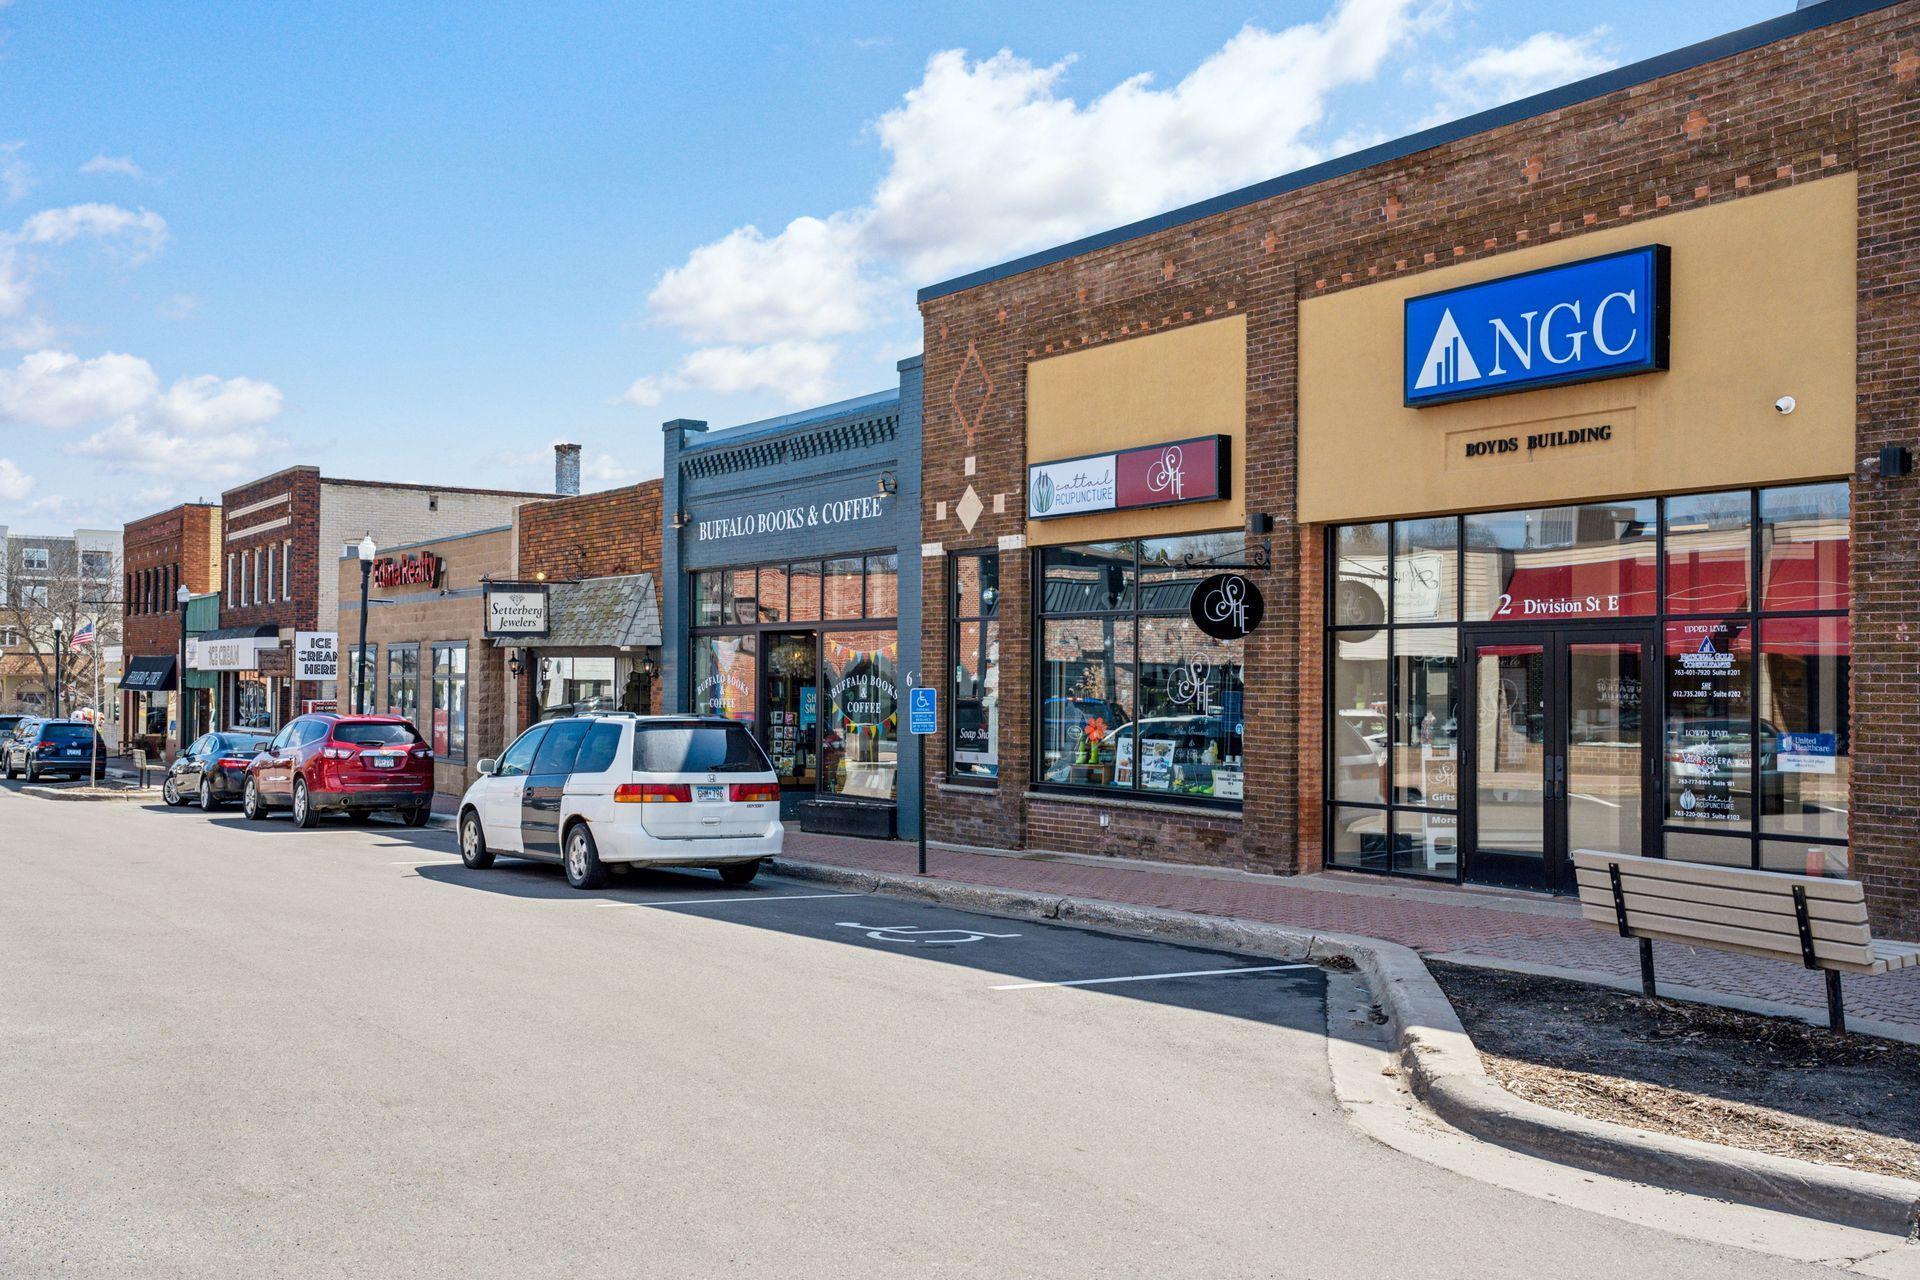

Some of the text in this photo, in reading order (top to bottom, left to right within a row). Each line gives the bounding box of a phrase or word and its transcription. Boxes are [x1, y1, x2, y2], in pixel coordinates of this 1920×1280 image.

[1488, 289, 1637, 377] NGC
[1465, 425, 1611, 457] BOYDS BUILDING
[1146, 445, 1186, 500] SHE
[1055, 470, 1113, 491] cattail
[1055, 487, 1113, 506] ACUPUNCTURE
[699, 496, 882, 541] BUFFALO BOOKS & COFFEE
[373, 551, 441, 589] Edina Realty
[492, 602, 543, 619] Setterberg
[1204, 576, 1250, 634] SHE
[1498, 593, 1619, 615] 2 Division St E
[499, 617, 537, 630] Jewelers
[1684, 625, 1708, 633] UPPER
[310, 638, 332, 649] ICE
[304, 664, 337, 675] HERE
[696, 674, 750, 697] BUFFALO BOOKS
[831, 674, 899, 700] BUFFALO BOOKS
[859, 688, 868, 700] &
[1713, 690, 1727, 698] Suite
[709, 698, 736, 709] COFFEE
[847, 701, 881, 714] COFFEE
[960, 727, 977, 741] Soap
[1795, 744, 1830, 752] Healthcare
[1702, 757, 1732, 766] SOLERA
[1432, 793, 1456, 802] Gifts
[1696, 802, 1734, 810] ACUPUNCTURE
[1432, 816, 1457, 825] More
